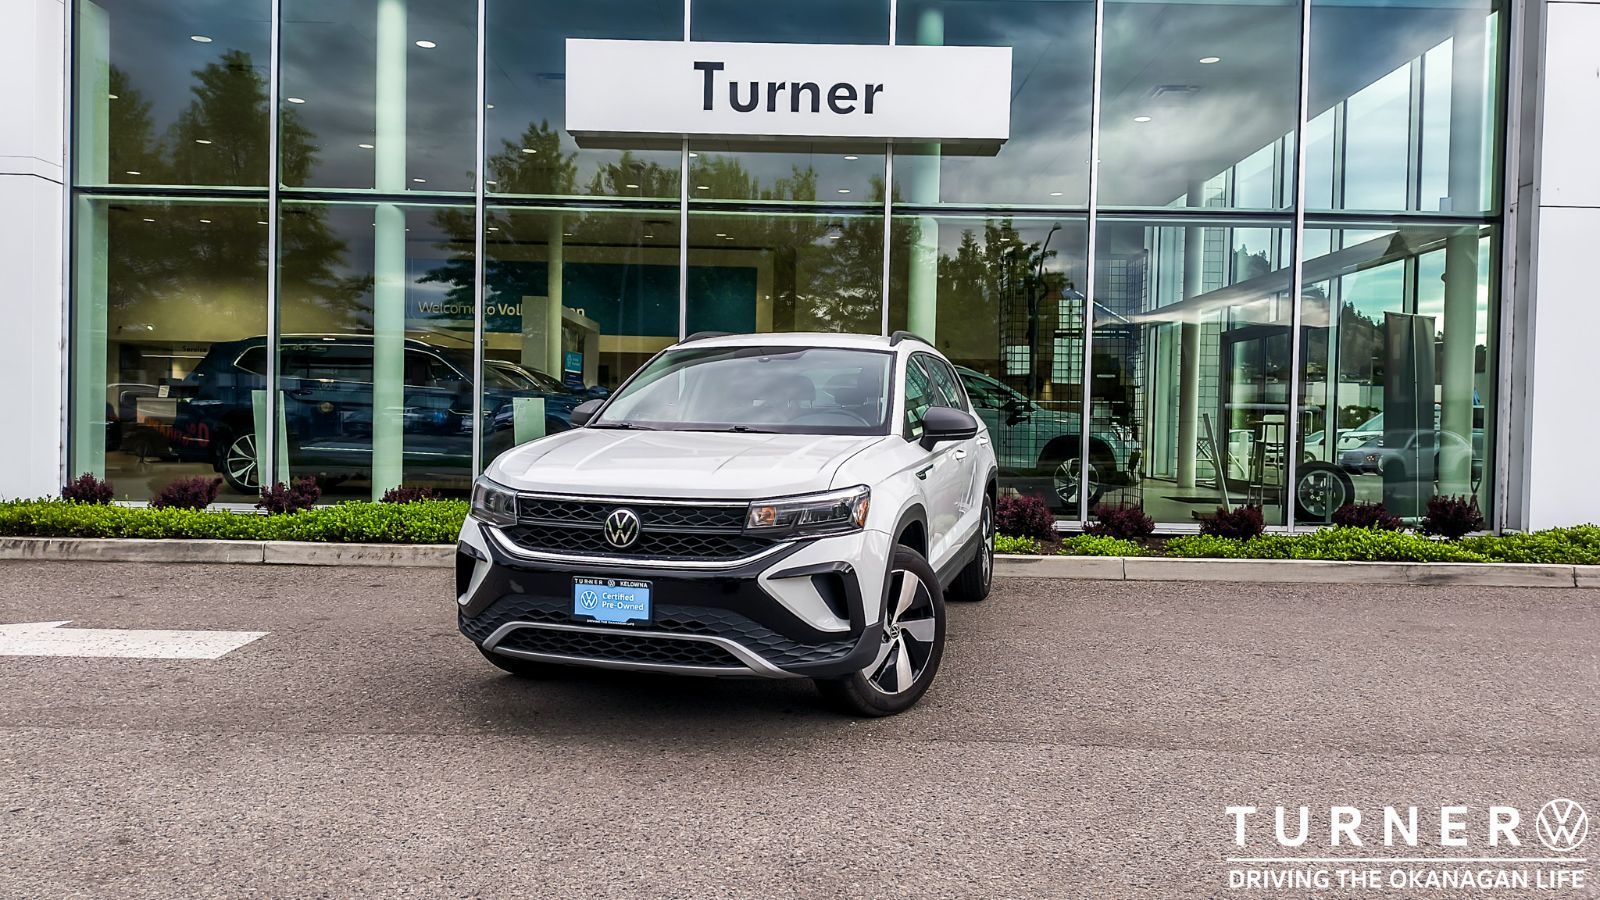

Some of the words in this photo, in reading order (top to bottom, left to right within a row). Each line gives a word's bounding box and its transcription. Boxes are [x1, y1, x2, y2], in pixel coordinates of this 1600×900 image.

[694, 61, 884, 115] Turner
[602, 592, 634, 602] Certified
[602, 601, 644, 611] Pre-Owned
